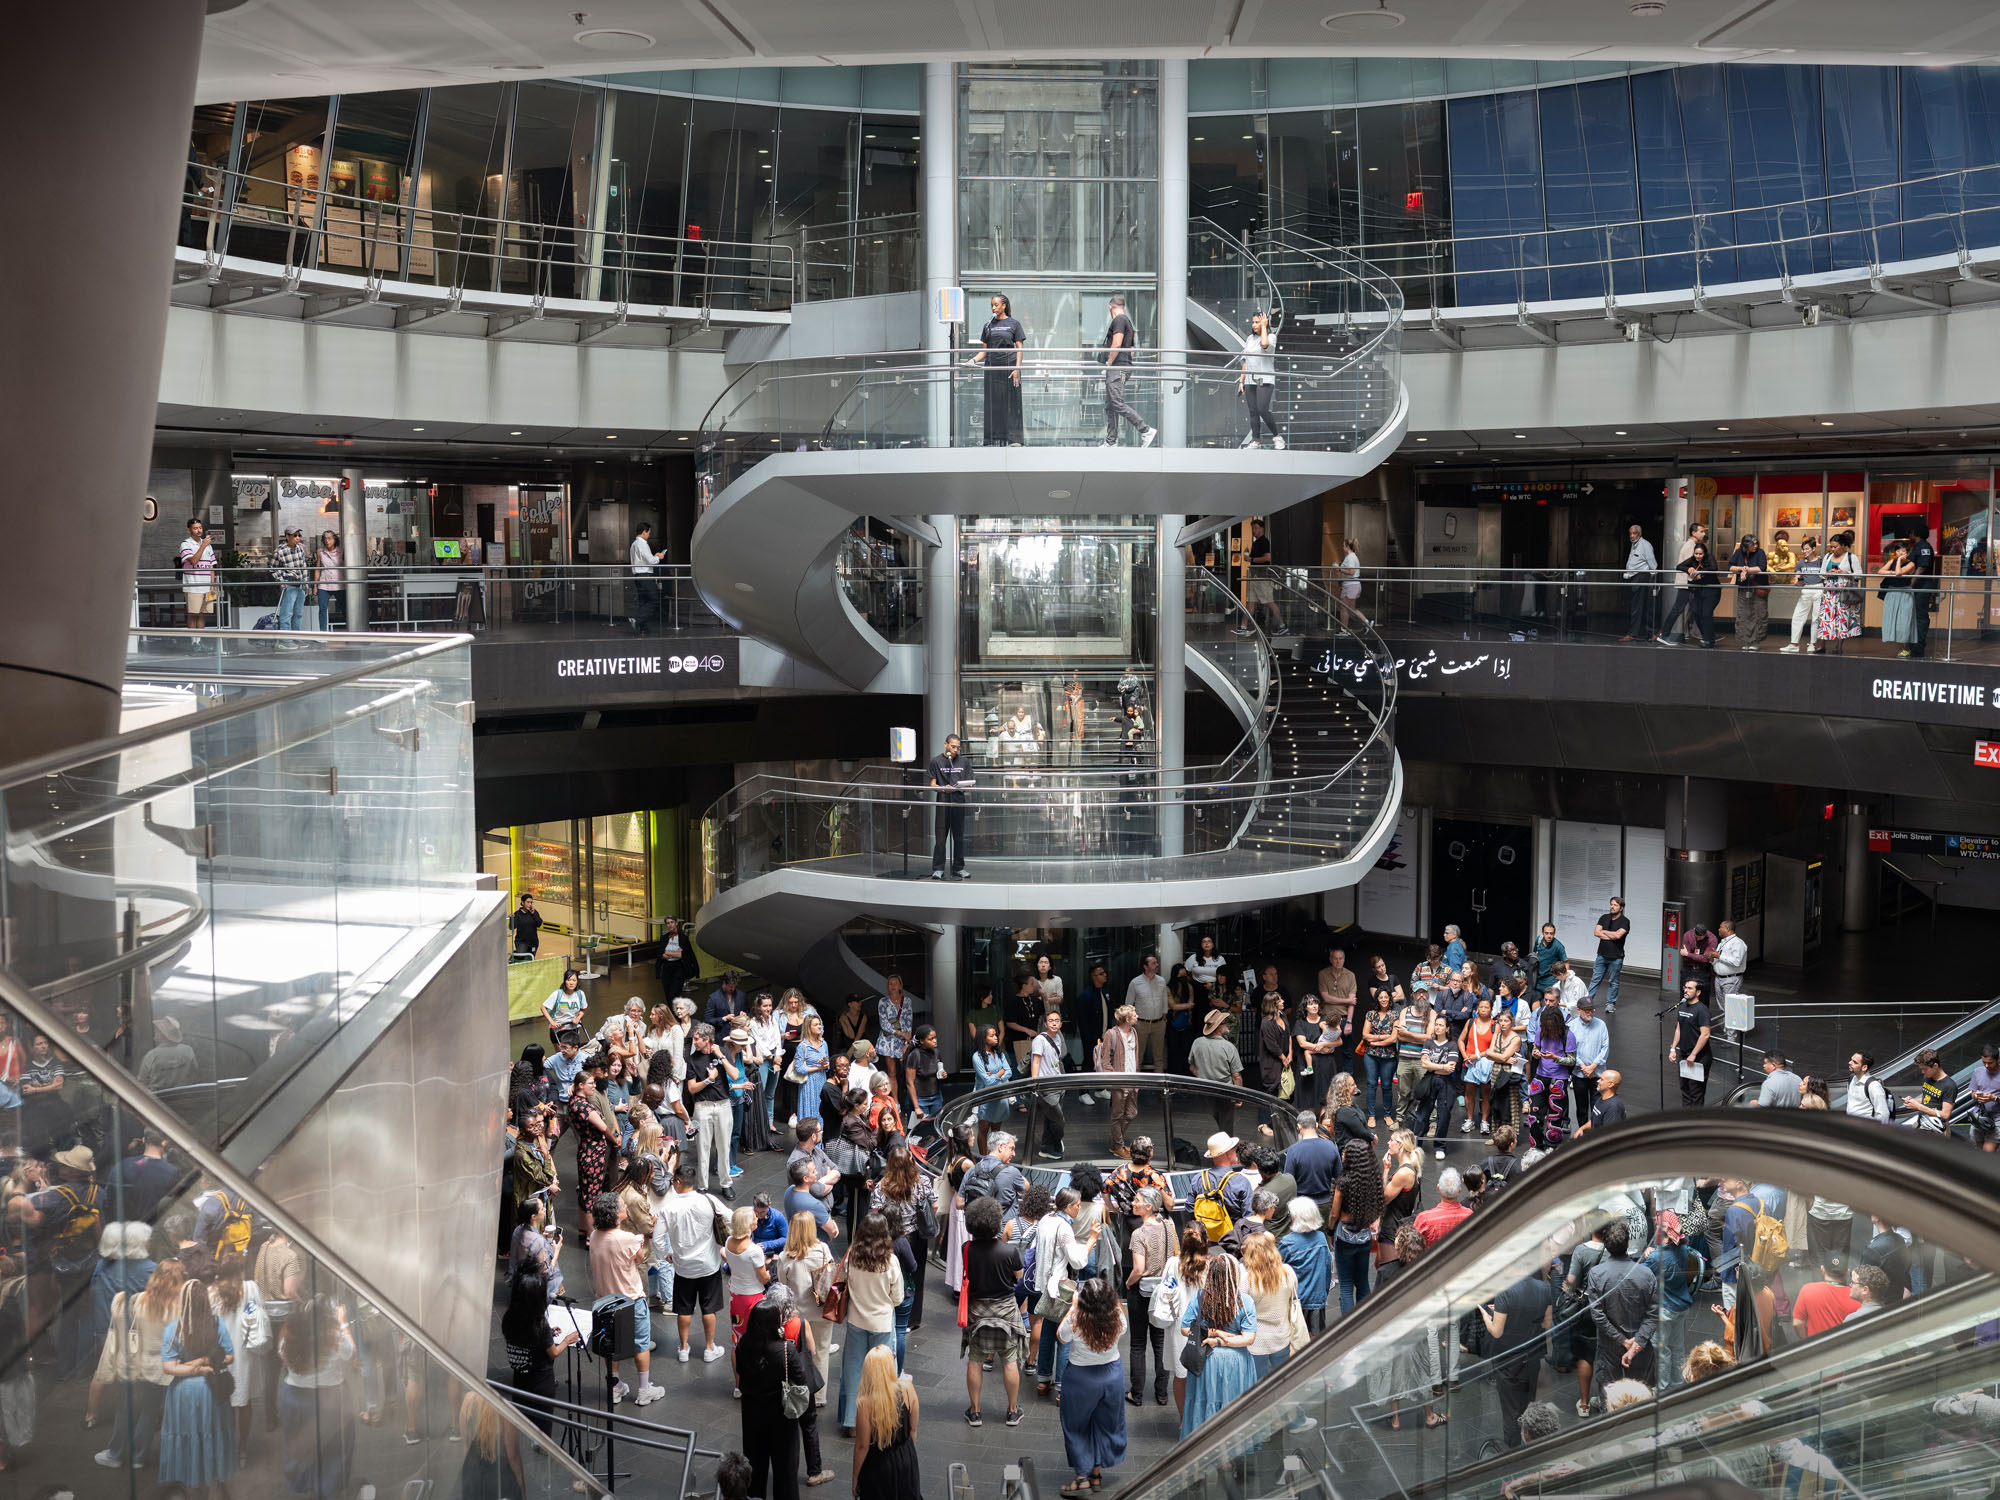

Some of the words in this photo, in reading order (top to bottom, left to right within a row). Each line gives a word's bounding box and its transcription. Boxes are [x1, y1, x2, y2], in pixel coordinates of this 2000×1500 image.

[233, 478, 265, 497] Tea
[280, 478, 332, 498] Boba
[519, 496, 562, 524] Coffee
[558, 656, 662, 677] CREATIVETIME
[1440, 653, 1490, 675] سمعت
[1872, 678, 1985, 706] CREATIVETIME
[1975, 741, 2000, 763] Ex
[1868, 830, 1889, 840] Exit
[1890, 832, 1909, 840] John
[1910, 833, 1932, 841] Street
[1959, 836, 1989, 846] Elevator
[1991, 837, 1999, 846] to
